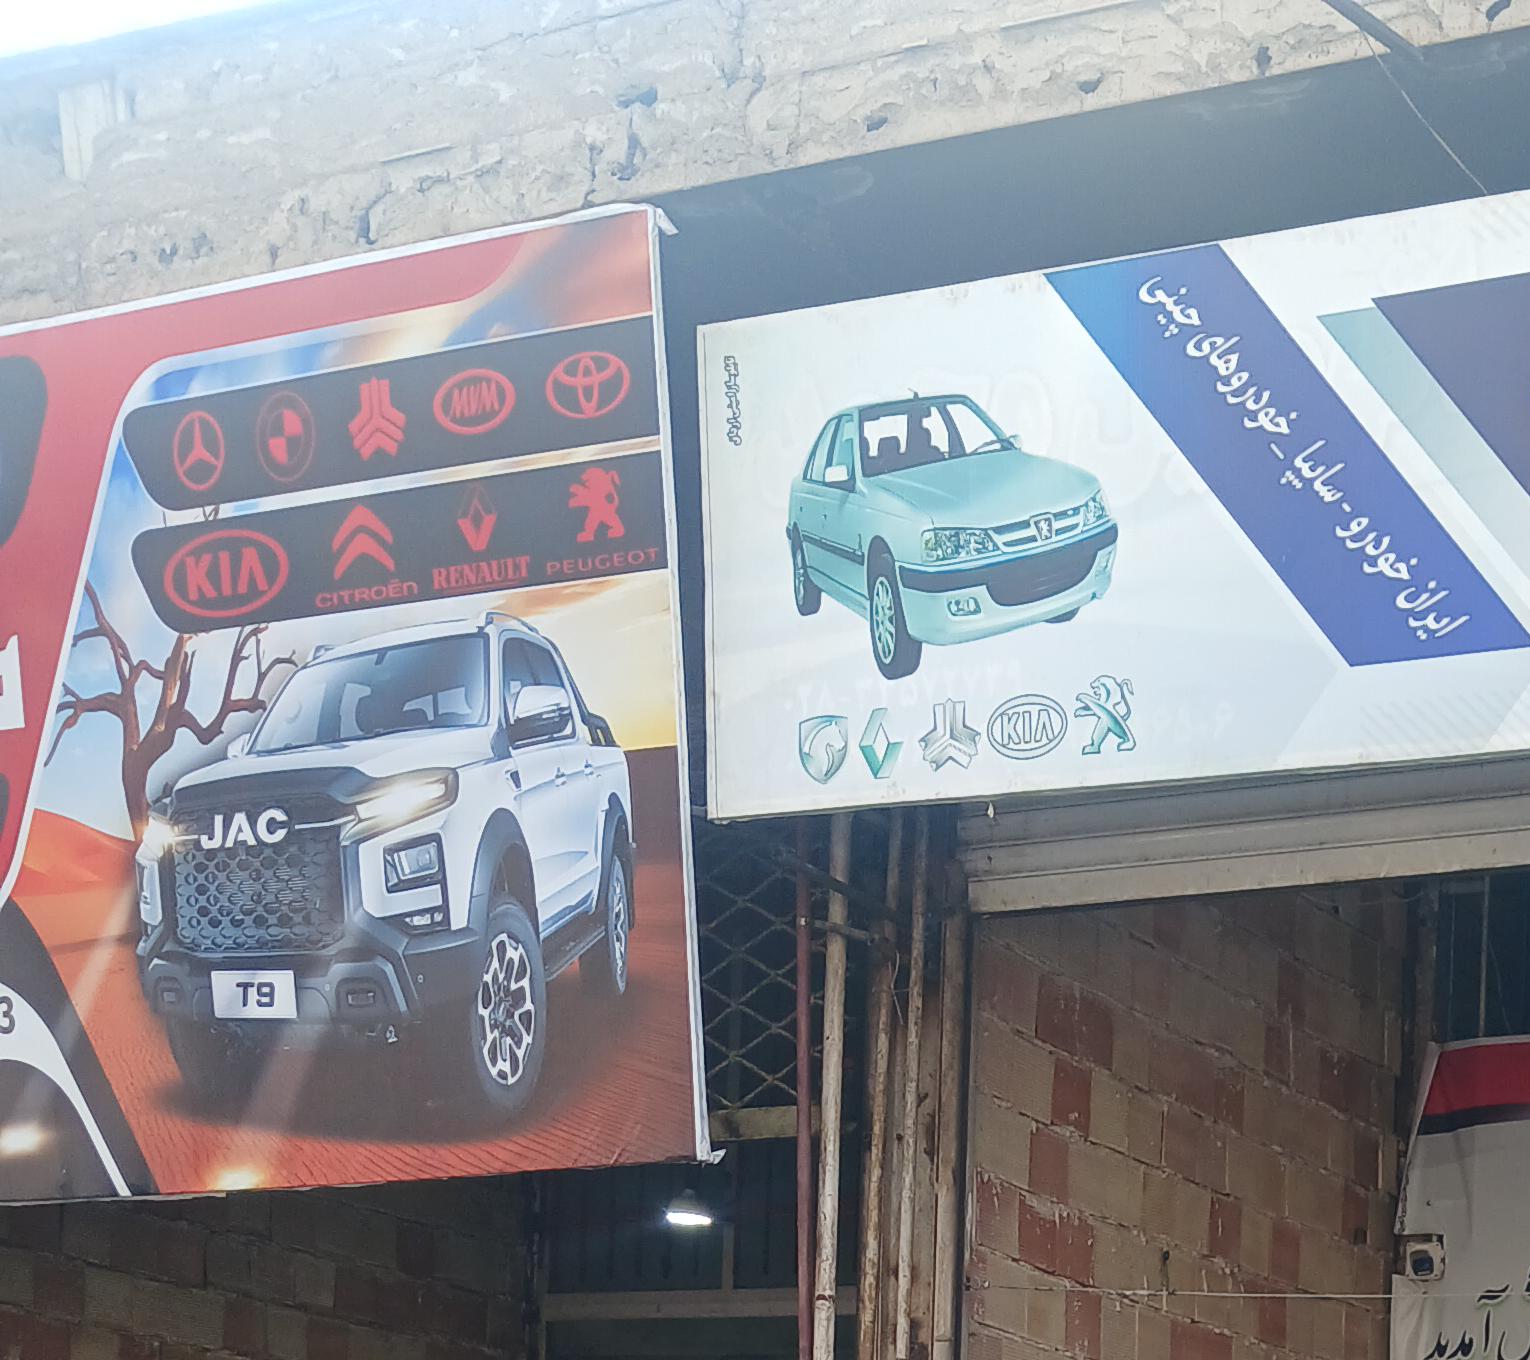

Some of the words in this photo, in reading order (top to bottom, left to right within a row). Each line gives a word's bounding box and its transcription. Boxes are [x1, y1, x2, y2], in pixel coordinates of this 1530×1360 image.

[1138, 276, 1202, 337] چینی
[450, 381, 500, 419] MVM
[1186, 333, 1298, 435] خودروهای
[1279, 439, 1345, 502] سایپا
[546, 547, 660, 577] PEUGEOT
[1335, 516, 1419, 581] خودرو
[184, 547, 270, 601] KIA
[432, 555, 531, 592] RENAULT
[1395, 580, 1470, 640] ایران
[1000, 709, 1056, 746] KIA
[199, 808, 290, 850] JAC
[235, 980, 276, 1008] T9
